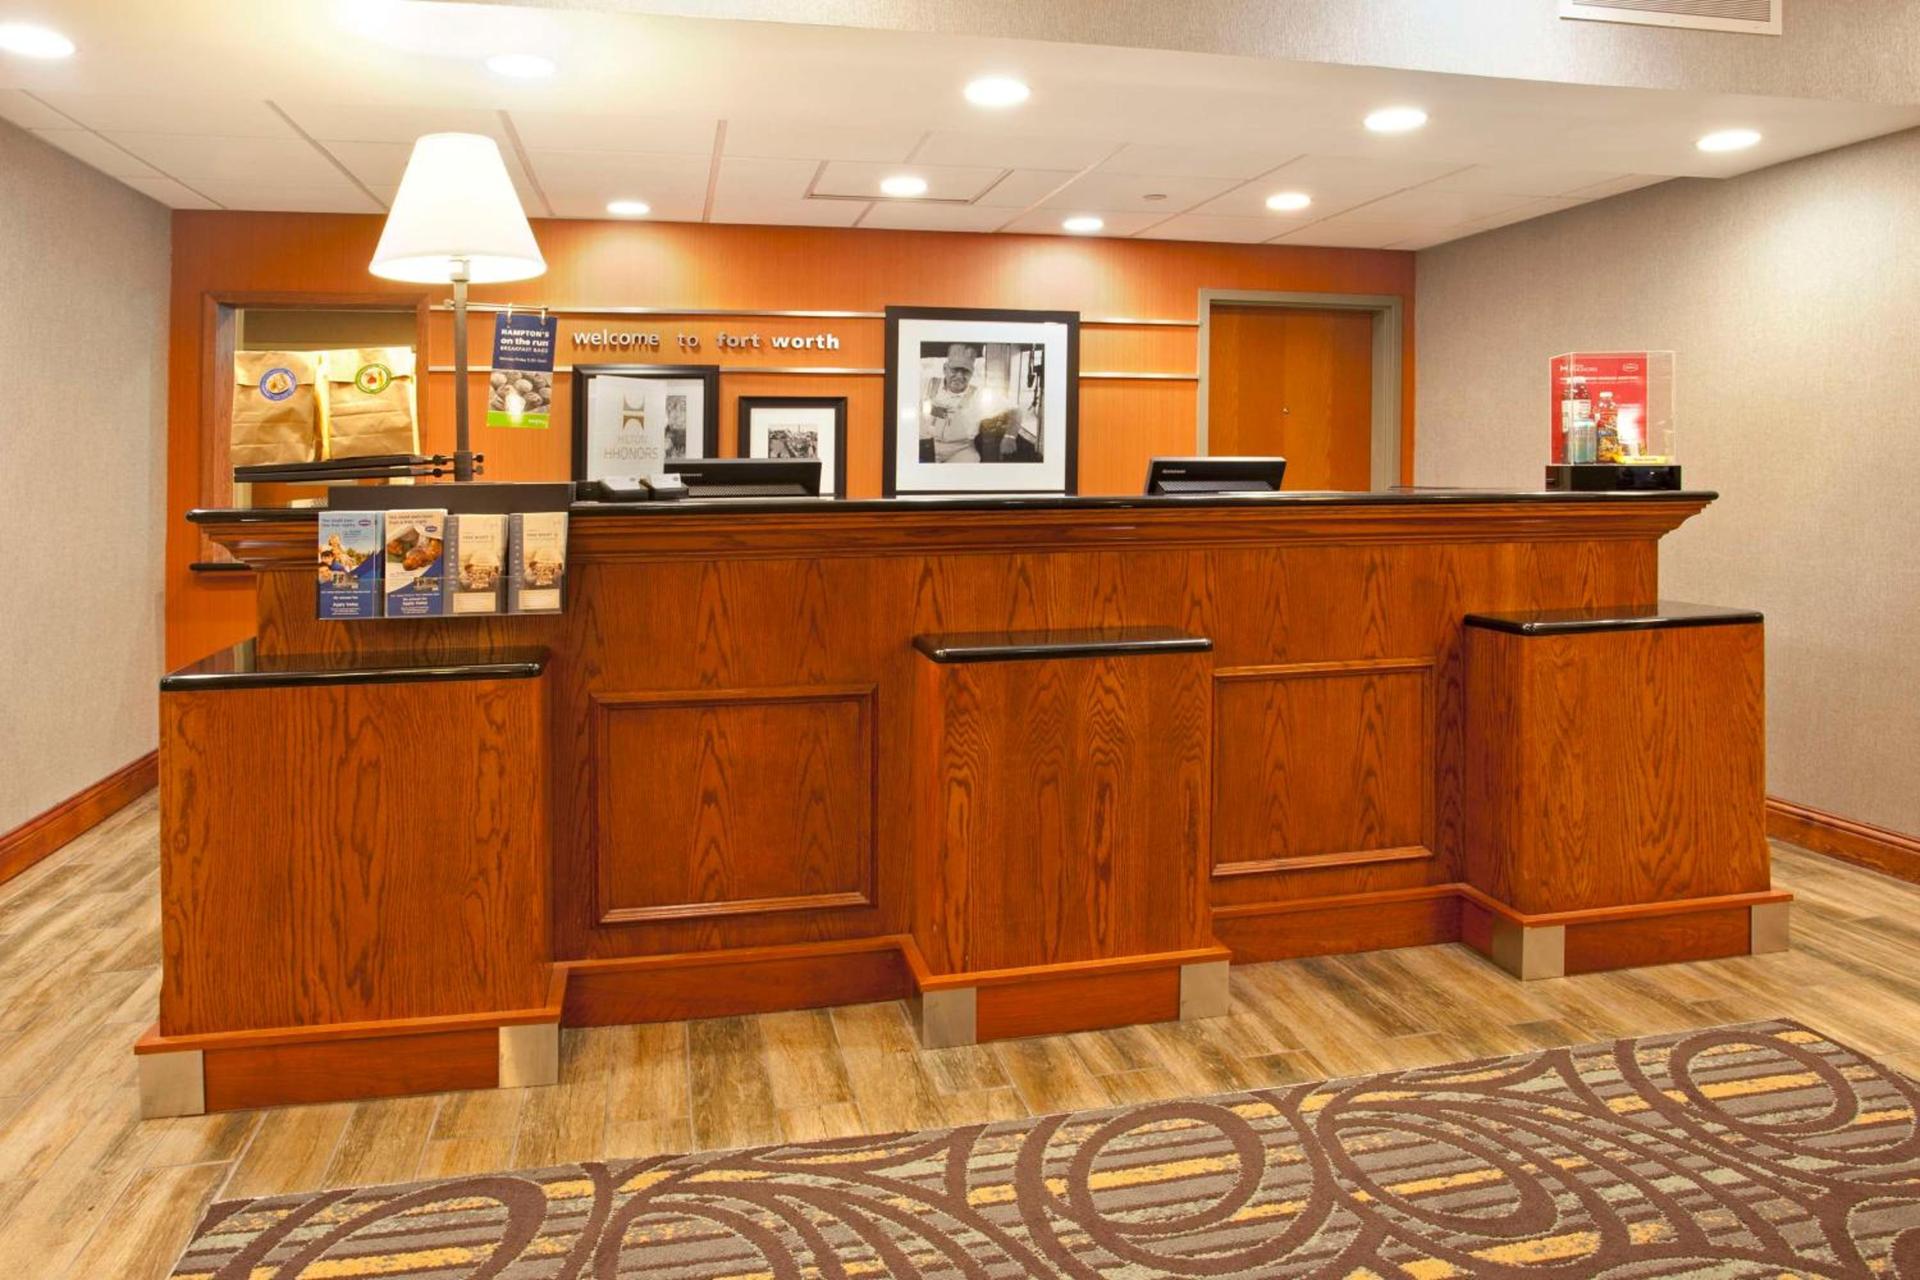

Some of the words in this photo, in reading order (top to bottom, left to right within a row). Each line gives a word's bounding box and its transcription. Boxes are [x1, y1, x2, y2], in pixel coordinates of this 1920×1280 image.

[501, 329, 550, 338] HAMPTON'S
[515, 337, 531, 346] the
[573, 329, 659, 346] welcome
[676, 332, 699, 346] to
[716, 333, 760, 348] fort
[771, 333, 840, 350] worth
[603, 447, 658, 460] HHONORS
